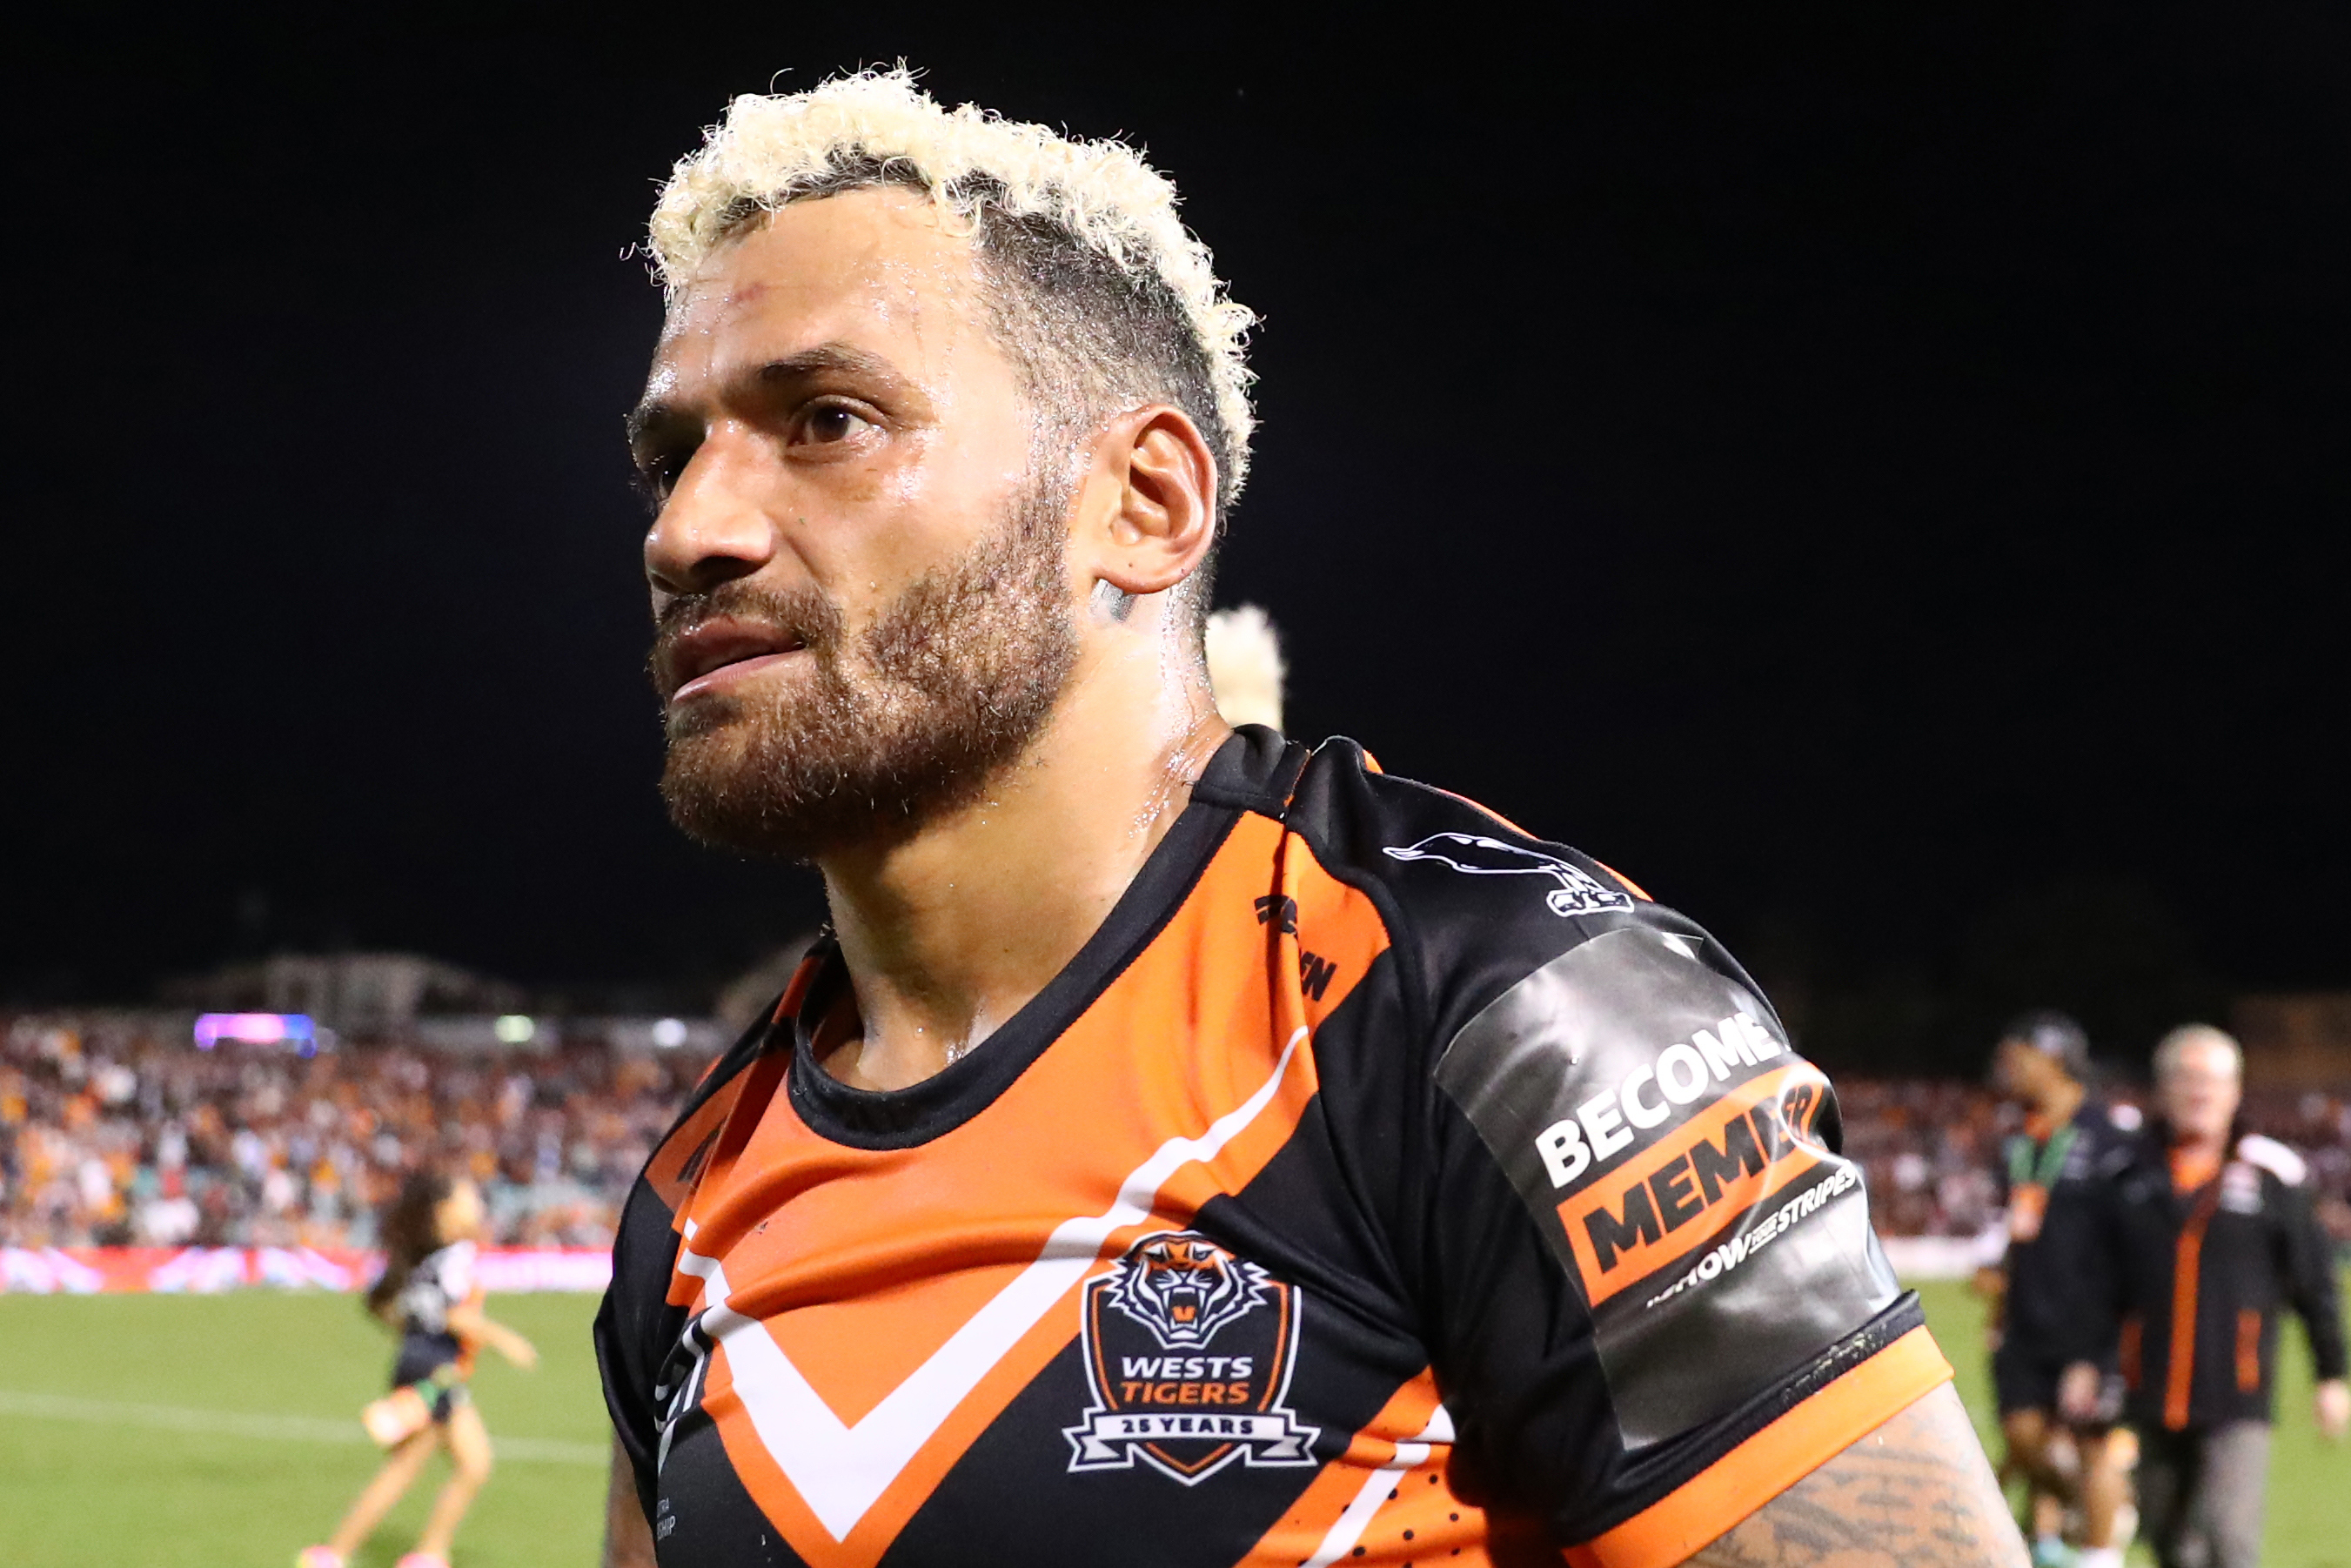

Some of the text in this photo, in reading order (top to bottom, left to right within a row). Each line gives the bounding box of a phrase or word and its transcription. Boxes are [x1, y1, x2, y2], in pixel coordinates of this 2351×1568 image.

[1535, 1011, 1782, 1189] BECOME
[1122, 1356, 1253, 1379] WESTS
[1120, 1380, 1250, 1404] TIGERS
[1122, 1417, 1253, 1435] 25 YEARS
